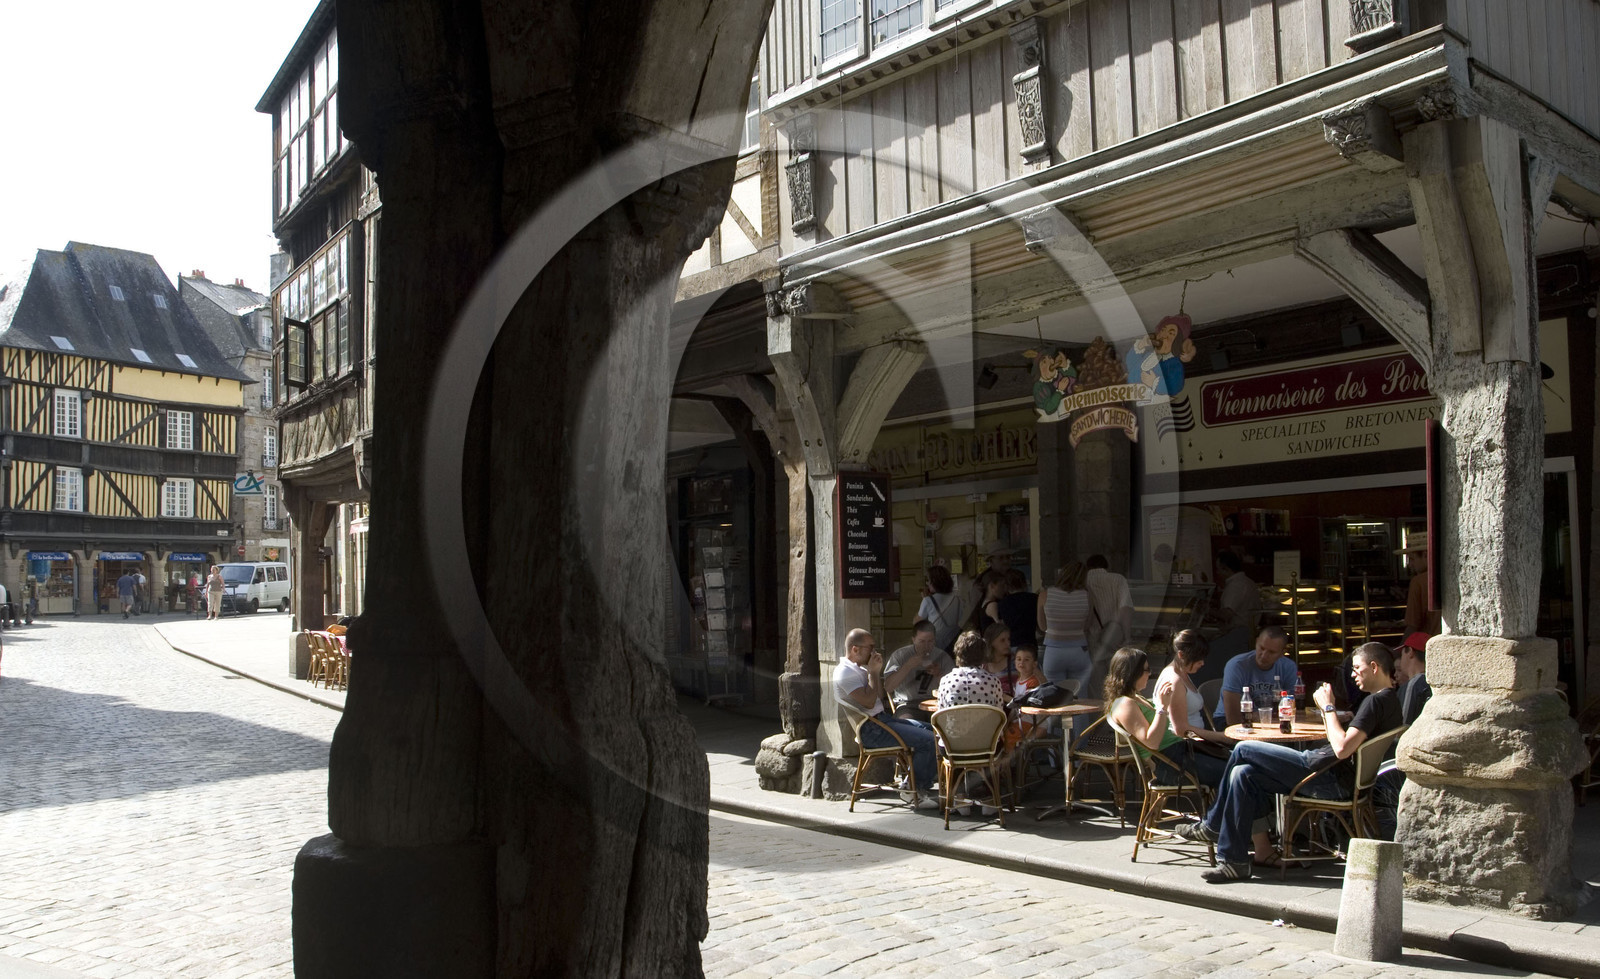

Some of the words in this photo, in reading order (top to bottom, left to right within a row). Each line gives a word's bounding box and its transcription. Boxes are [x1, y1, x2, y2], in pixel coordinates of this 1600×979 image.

[1212, 378, 1325, 417] Viennoiserie
[1335, 371, 1368, 401] des
[1072, 408, 1135, 436] SANDWICHERIE
[1241, 419, 1326, 442] SPECIALITES
[1287, 432, 1380, 455] SANDWICHES
[846, 482, 864, 490] Paninis
[846, 494, 874, 502] Sandwiches
[847, 518, 860, 526] Cafés
[847, 530, 868, 538] Chocolat
[848, 554, 877, 562] Viennoiserie
[868, 566, 886, 574] Bretons
[848, 578, 865, 586] Glaces
